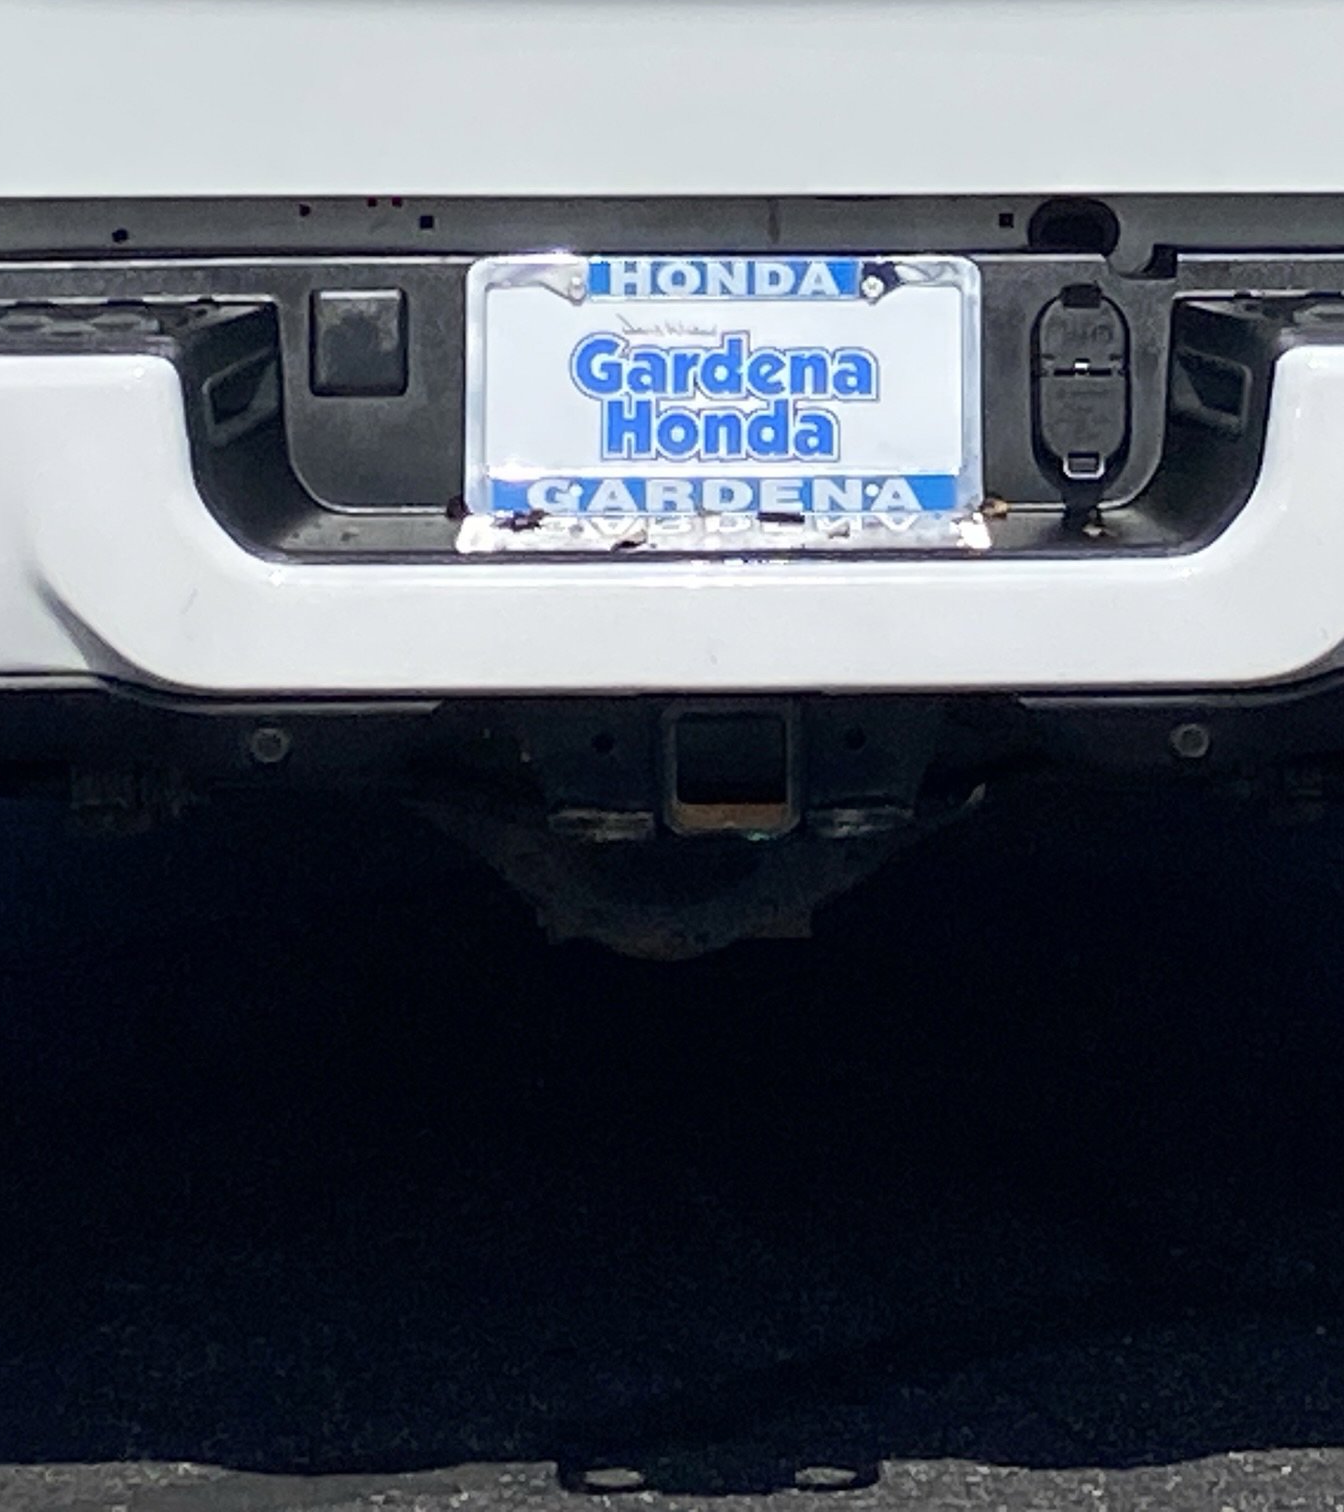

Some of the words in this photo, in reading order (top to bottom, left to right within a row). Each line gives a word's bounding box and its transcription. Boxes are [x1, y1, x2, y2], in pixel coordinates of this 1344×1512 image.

[608, 261, 843, 297] HONDA
[572, 333, 876, 399] Gardena
[605, 399, 836, 458] Honda
[525, 478, 923, 512] GARDENA
